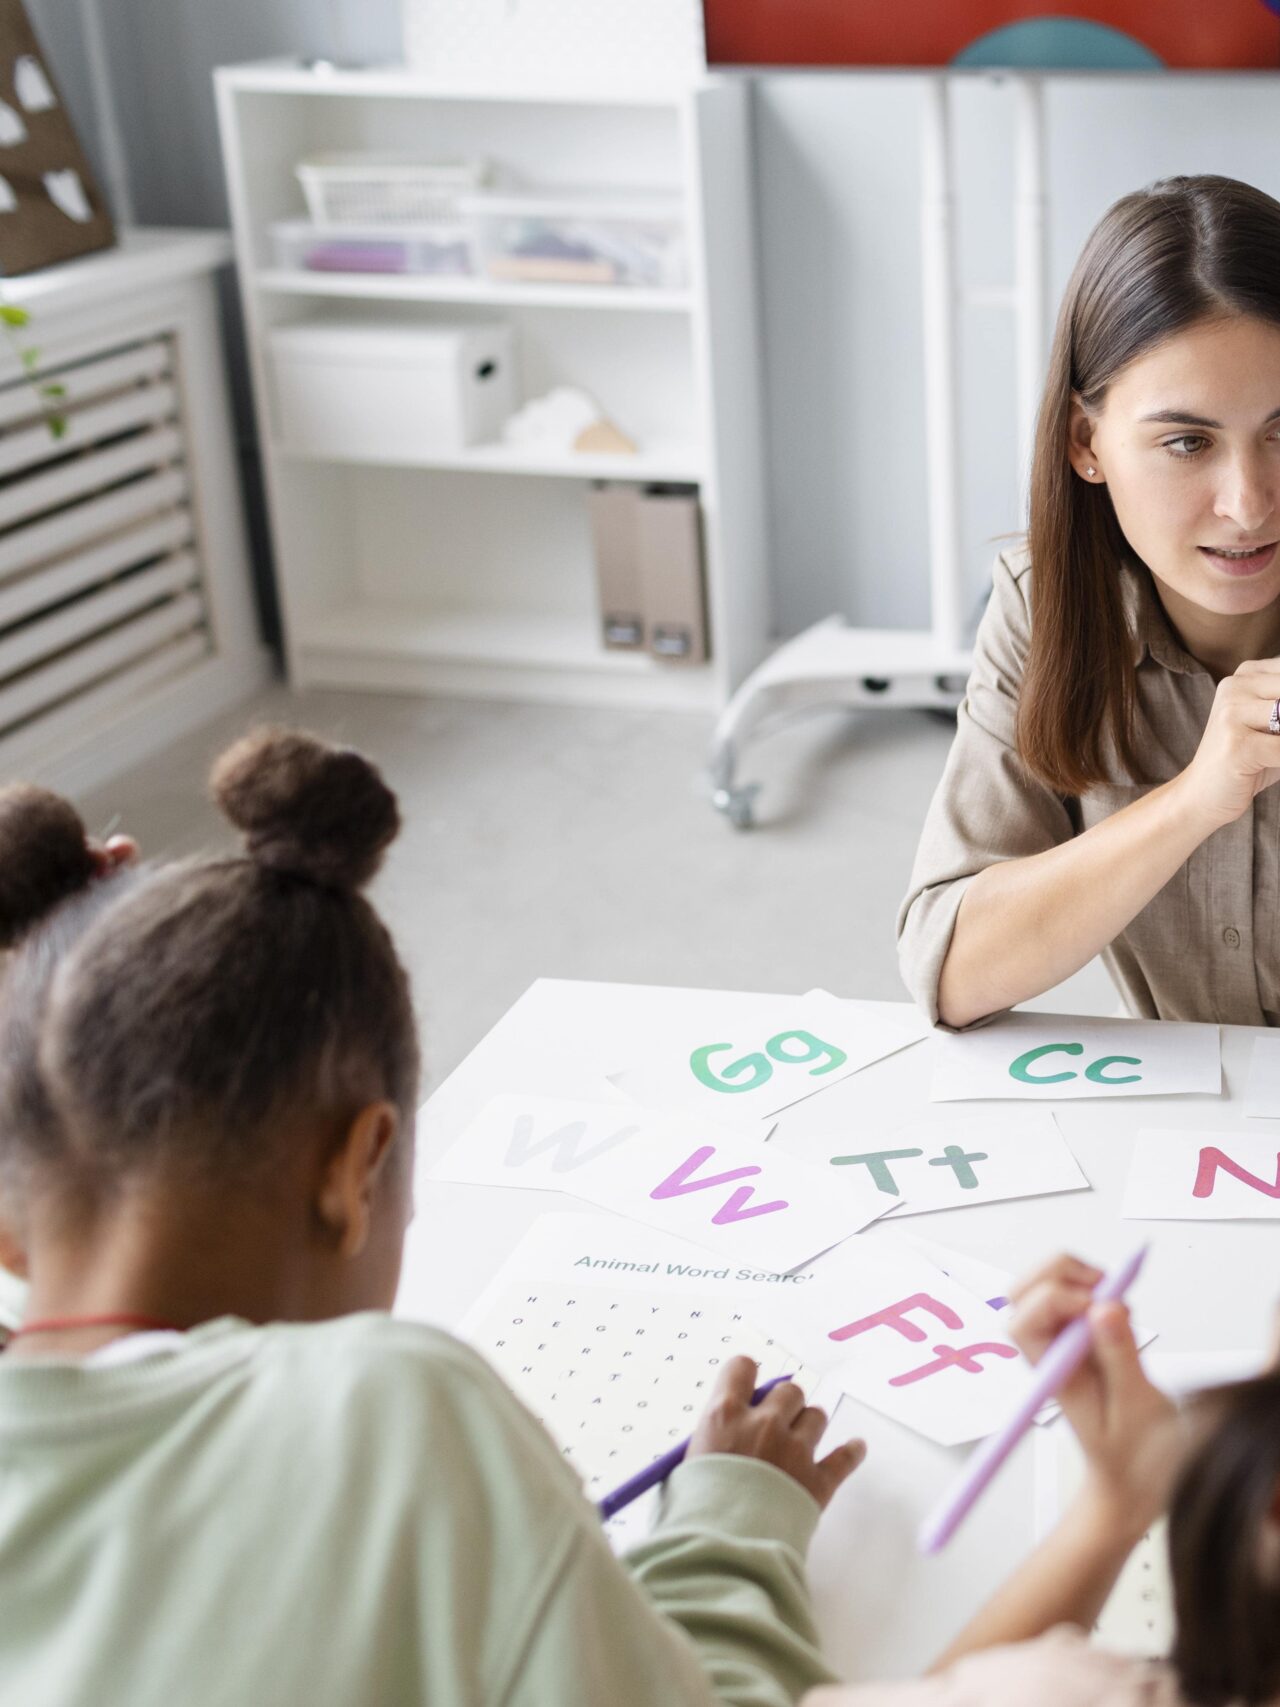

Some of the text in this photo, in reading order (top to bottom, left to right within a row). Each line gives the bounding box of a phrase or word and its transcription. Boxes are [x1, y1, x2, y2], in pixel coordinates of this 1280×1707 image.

[689, 1029, 848, 1094] Gg
[1008, 1042, 1142, 1085] Cc
[648, 1145, 790, 1226] Vv
[830, 1145, 988, 1196] Tt
[573, 1255, 814, 1285] Animal Word Searc
[827, 1292, 1020, 1388] Ff
